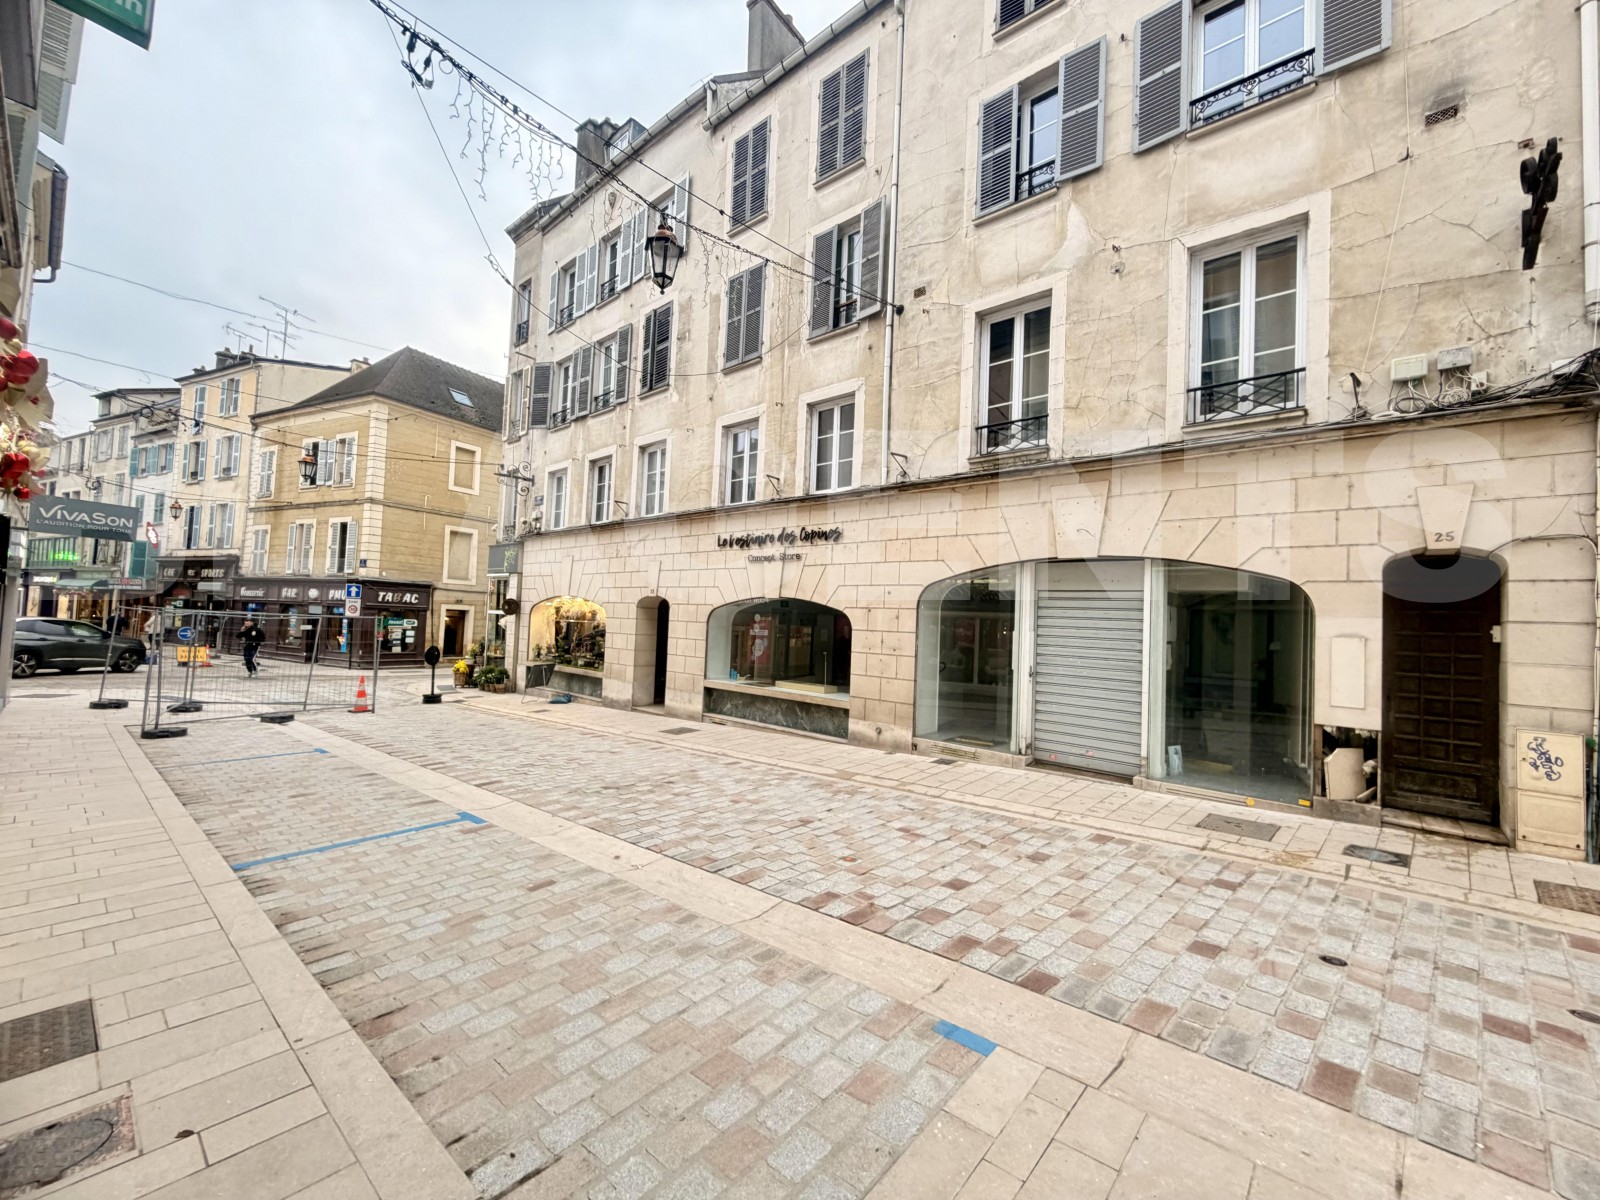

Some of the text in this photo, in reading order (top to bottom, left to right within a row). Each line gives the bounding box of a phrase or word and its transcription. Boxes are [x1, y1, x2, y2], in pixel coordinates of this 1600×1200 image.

[36, 519, 85, 529] L'AUDITION
[87, 524, 110, 532] POUR
[717, 535, 727, 548] Le
[777, 527, 797, 545] des
[800, 527, 842, 544] Copines
[1434, 530, 1455, 543] 25
[747, 552, 801, 563] Concept Store
[377, 591, 419, 604] TABAC
